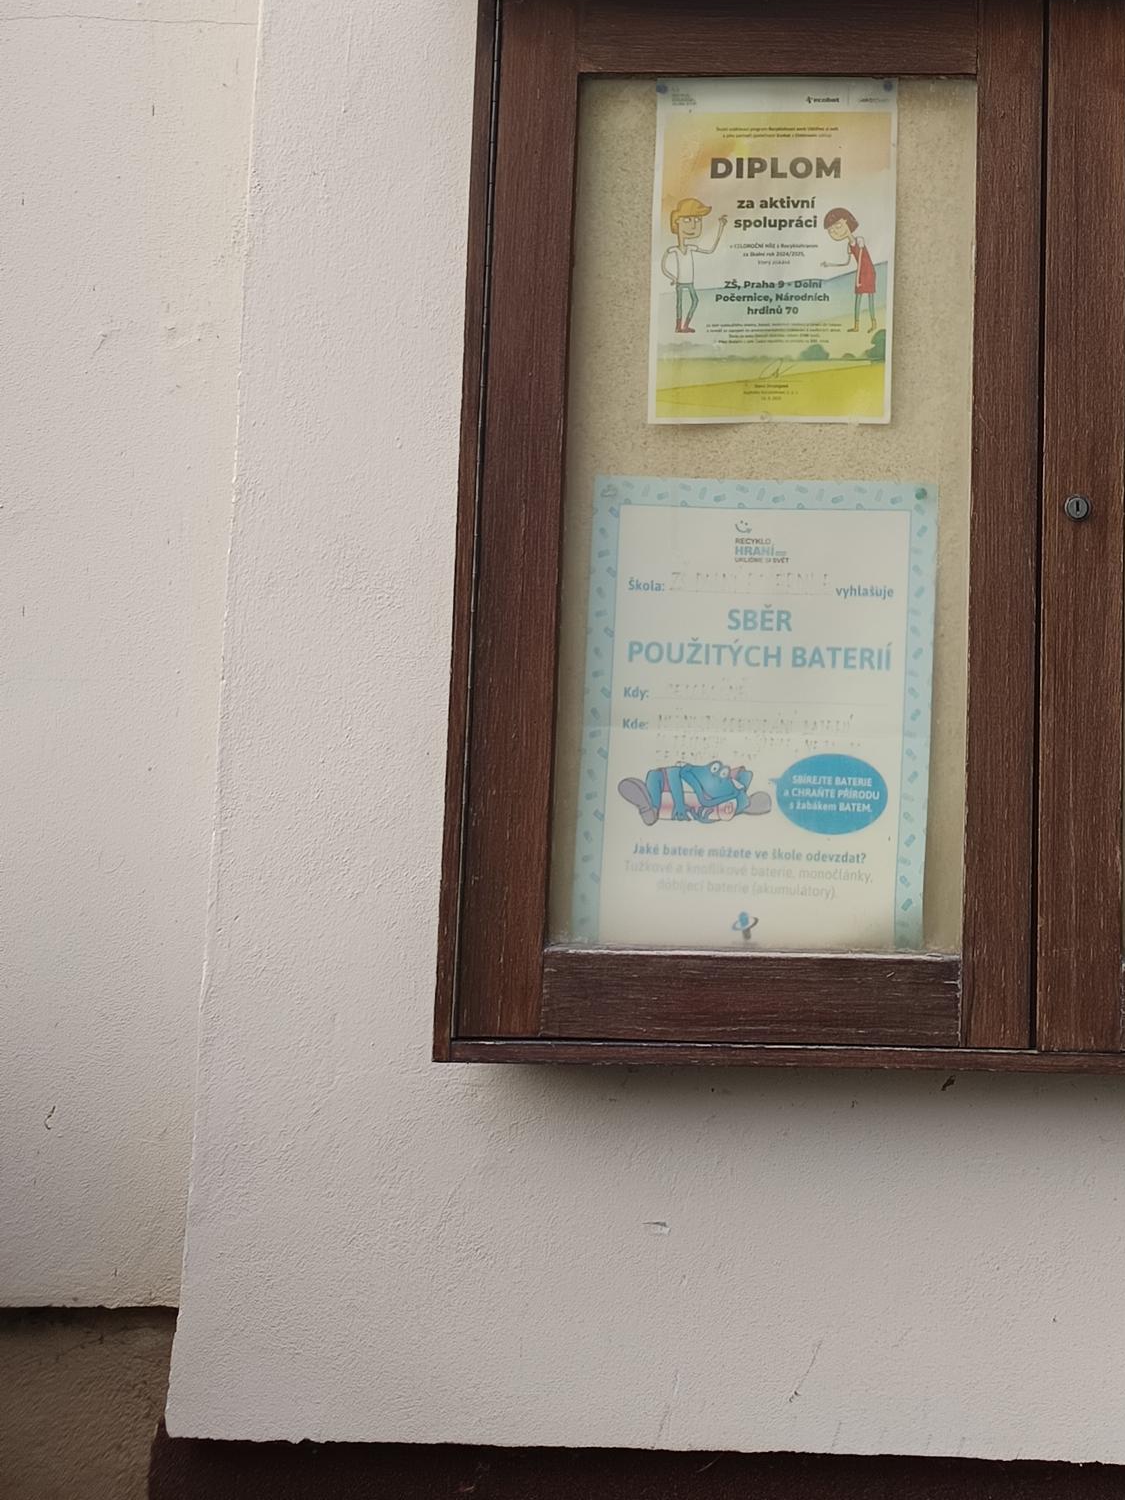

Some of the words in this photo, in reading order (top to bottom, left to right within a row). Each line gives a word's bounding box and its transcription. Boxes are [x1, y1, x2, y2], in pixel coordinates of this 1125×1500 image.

[710, 156, 842, 179] DIPLOM
[737, 199, 755, 209] za
[759, 196, 816, 209] aktivní
[734, 215, 817, 231] spolupráci
[724, 279, 740, 290] ZŠ,
[744, 280, 775, 288] Praha
[778, 280, 784, 288] 9
[794, 280, 822, 288] Dolní
[715, 293, 773, 304] Počernice,
[775, 293, 829, 301] Národních
[747, 305, 782, 315] hrdinů
[785, 306, 798, 315] 70
[734, 544, 774, 556] HRANÍ
[628, 577, 665, 591] Škola:
[836, 585, 894, 600] vyhlašuje
[727, 604, 792, 632] SBĚR
[628, 637, 782, 667] POUŽITÝCH
[791, 642, 893, 670] BATERIÍ
[624, 686, 649, 700] Kdy:
[622, 718, 648, 730] Kde:
[792, 775, 832, 785] SBÍREJTE
[835, 777, 872, 786] BATERIE
[791, 787, 835, 798] CHRAŇTE
[837, 788, 880, 800] PŘÍRODU
[795, 800, 836, 811] žabákem
[839, 802, 872, 812] BATEM.
[633, 843, 659, 855] Jaké
[662, 844, 704, 857] baterie
[708, 845, 752, 859] můžete
[754, 851, 768, 859] ve
[772, 848, 802, 861] škole
[806, 850, 866, 863] odevzdat?
[751, 866, 795, 879] baterie,
[799, 868, 873, 883] monočlánky,
[707, 882, 748, 894] baterie
